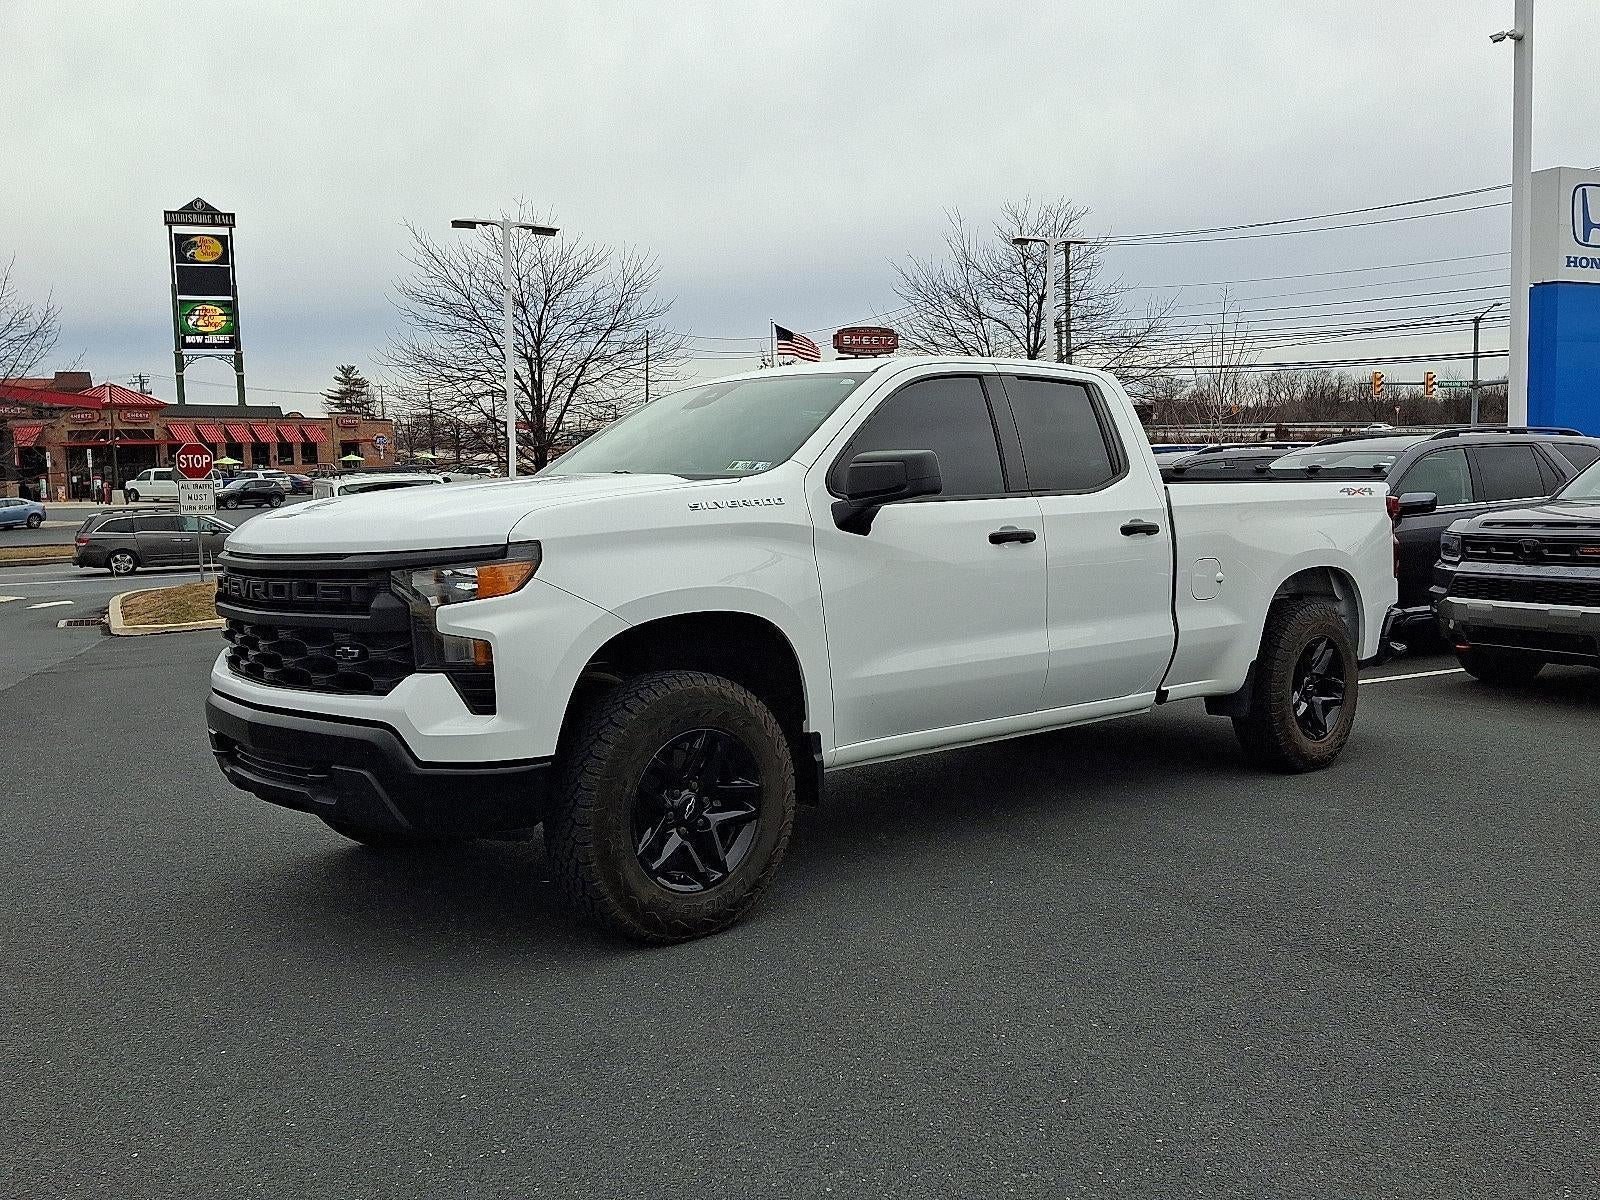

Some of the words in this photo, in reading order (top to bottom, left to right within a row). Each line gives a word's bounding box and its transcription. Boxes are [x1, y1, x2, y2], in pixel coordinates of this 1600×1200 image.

[165, 213, 212, 224] HARRISBURG
[214, 214, 234, 225] MALL
[185, 335, 204, 344] NOW
[842, 335, 895, 345] SHEETZ
[179, 454, 211, 469] STOP
[187, 493, 208, 501] MUST
[181, 504, 197, 512] TURN
[687, 497, 786, 512] SILVERADO
